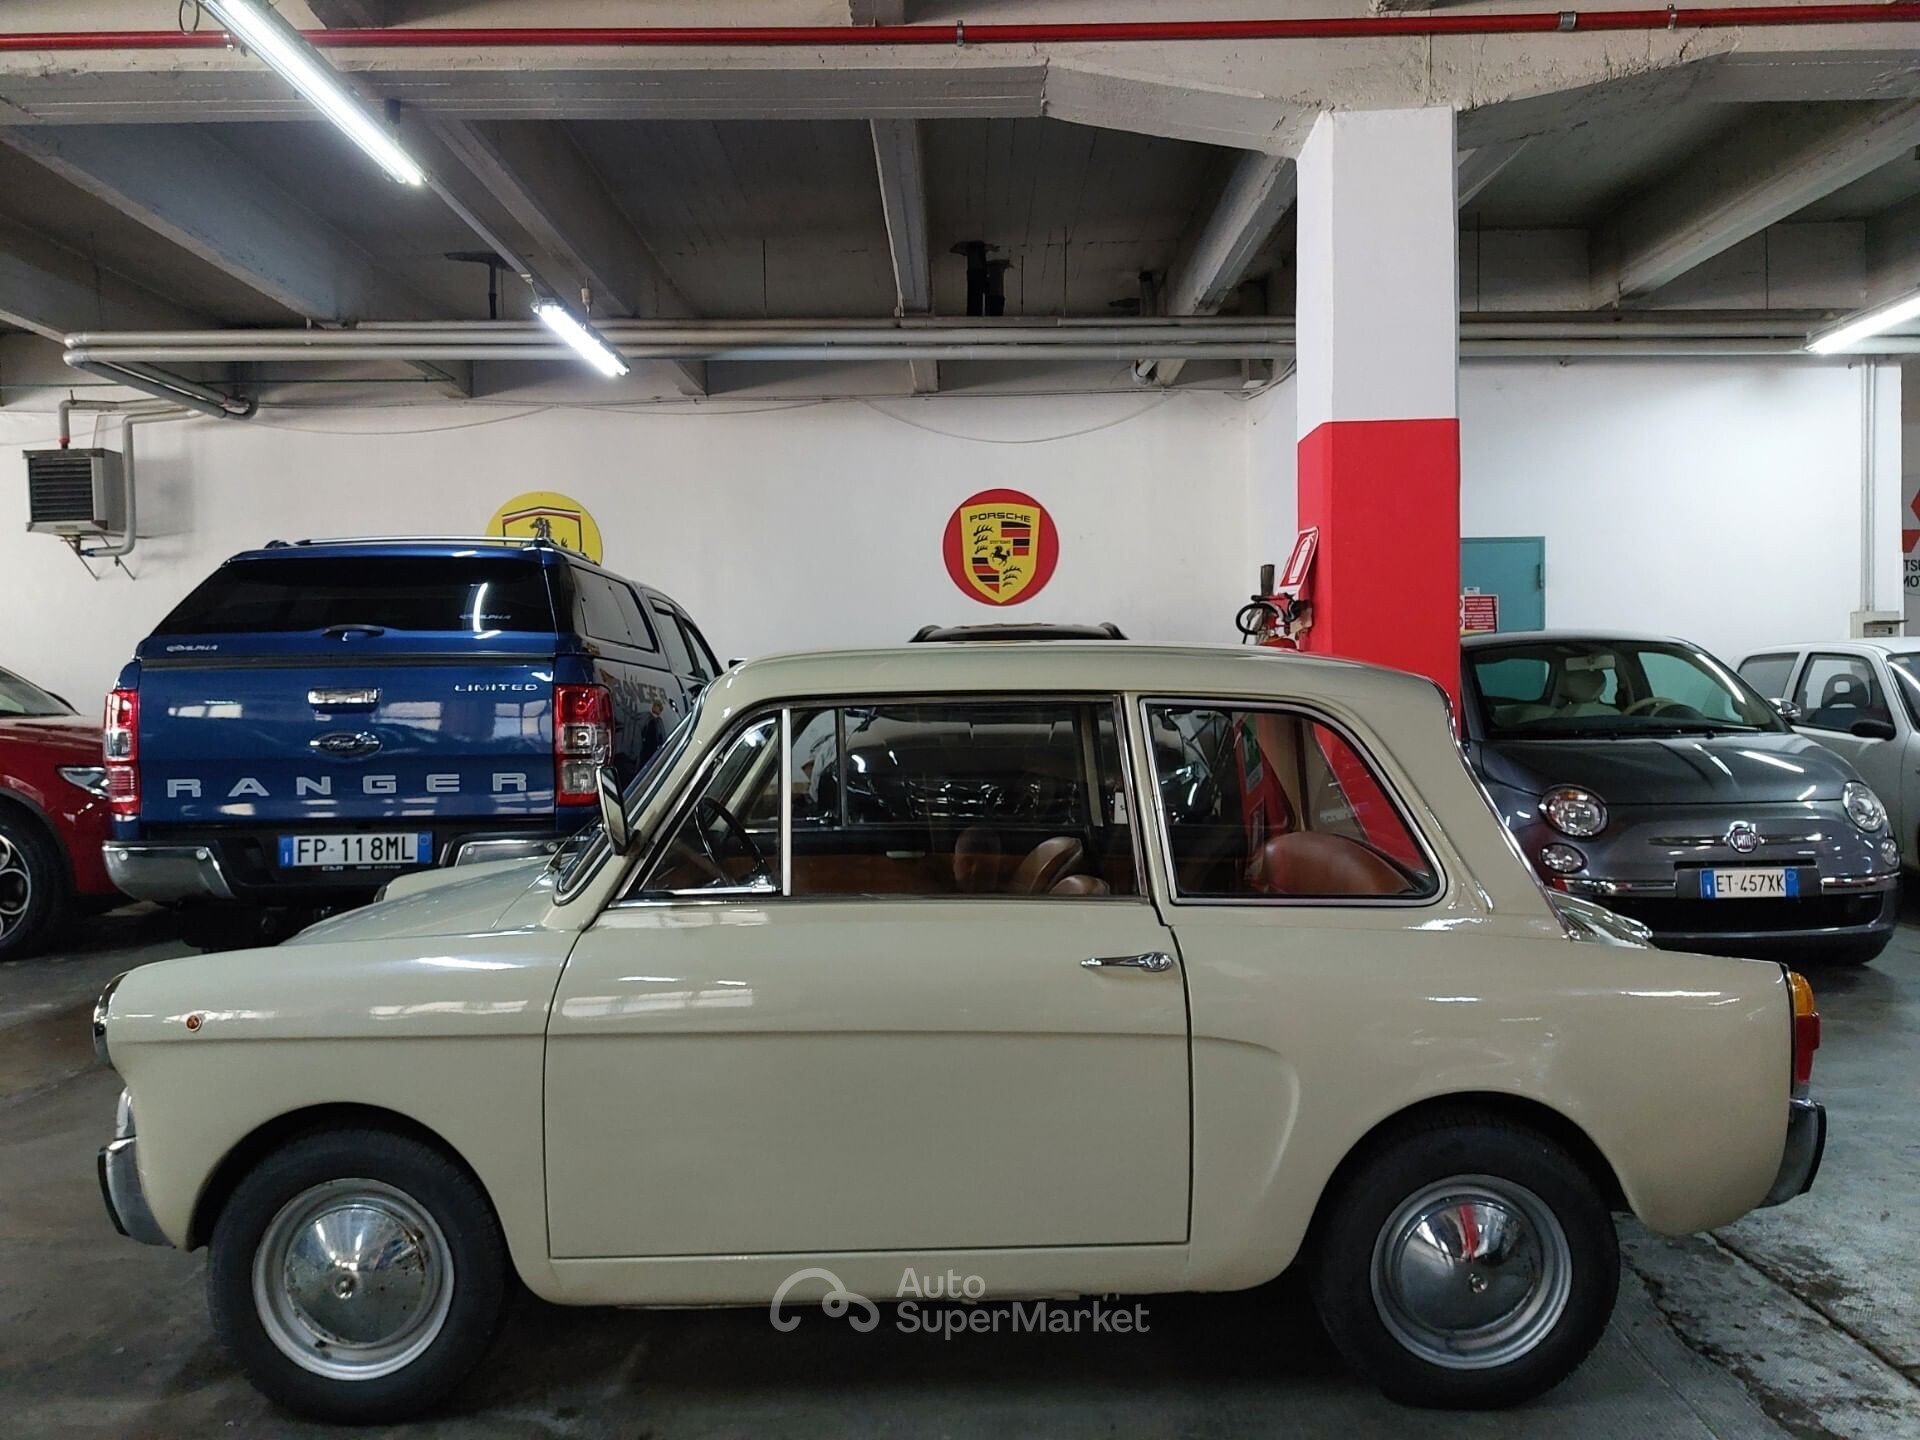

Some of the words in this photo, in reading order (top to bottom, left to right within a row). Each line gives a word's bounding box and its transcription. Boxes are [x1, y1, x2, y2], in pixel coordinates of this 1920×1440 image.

[970, 512, 1031, 523] PORSCHE
[454, 683, 538, 692] LIMITED
[166, 772, 527, 799] RANGER
